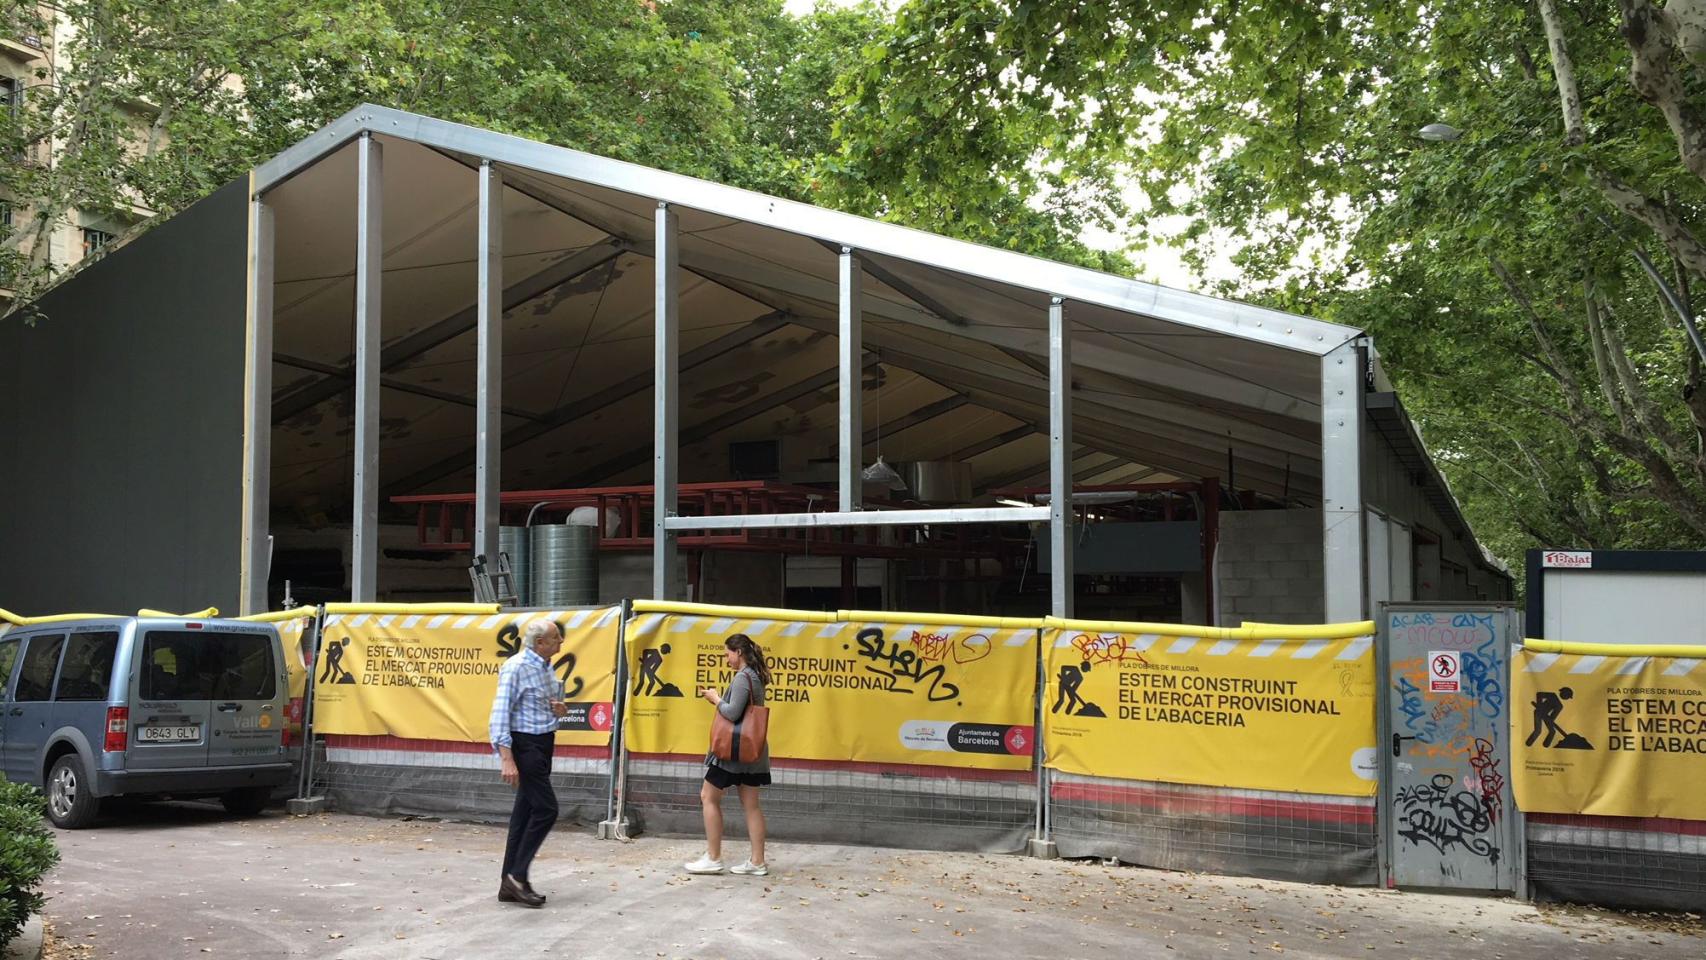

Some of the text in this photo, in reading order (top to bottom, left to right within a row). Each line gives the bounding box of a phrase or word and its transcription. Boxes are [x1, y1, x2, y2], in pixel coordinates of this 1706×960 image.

[367, 645, 482, 660] ESTEM CONSTRUINT
[365, 660, 502, 675] EL MERCAT PROVISIONA
[697, 654, 857, 673] EST ONSTRUINT
[362, 673, 445, 689] DE L'ABACERIA
[696, 670, 714, 682] EL
[786, 673, 891, 691] PROVISIONAL
[1119, 672, 1297, 696] ESTEM CONSTRUINT
[1119, 689, 1341, 716] EL MERCAT PROVISIONAL
[1607, 699, 1676, 715] ESTEM
[559, 715, 585, 723] arcelona
[1119, 705, 1246, 728] DE L'ABACERIA
[146, 727, 196, 738] 0643 GLY
[958, 729, 992, 737] Ajuntament
[1608, 717, 1706, 735] EL MERCA
[957, 736, 1000, 746] Barcelona
[1608, 736, 1706, 754] DE L'ABAC
